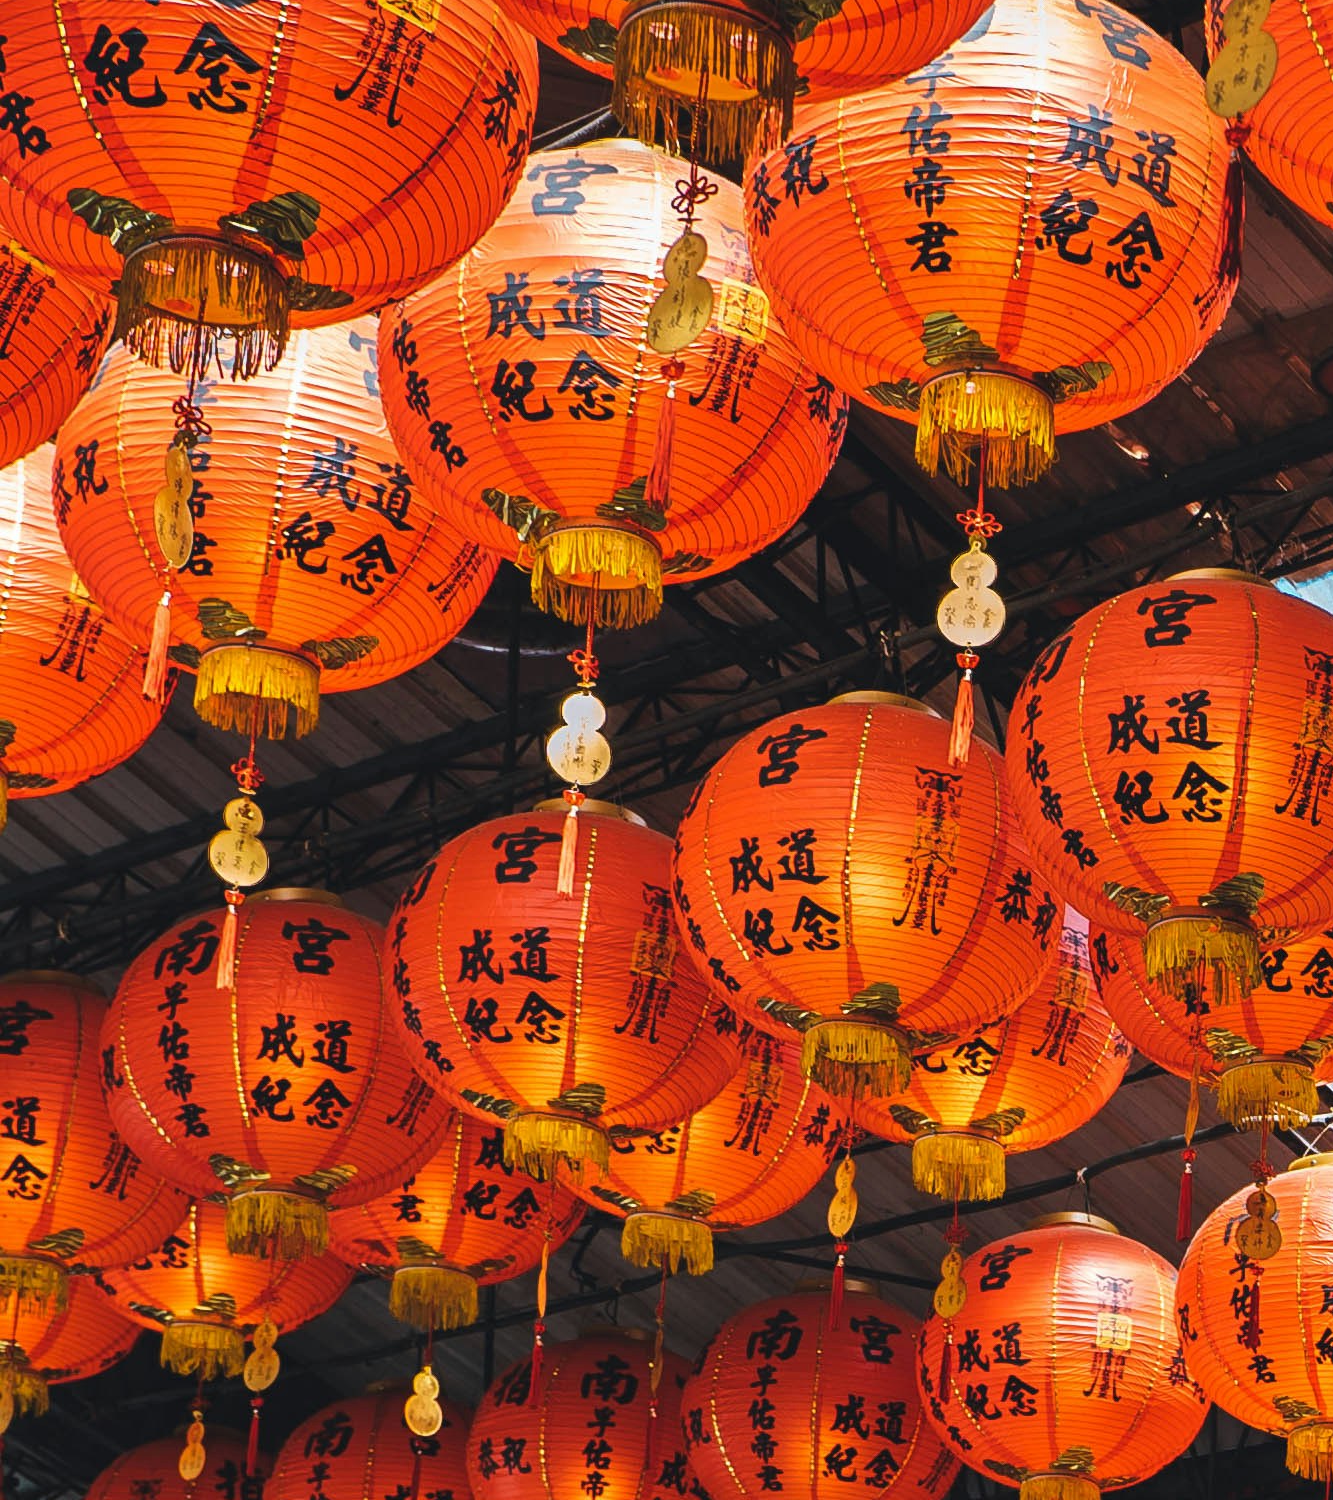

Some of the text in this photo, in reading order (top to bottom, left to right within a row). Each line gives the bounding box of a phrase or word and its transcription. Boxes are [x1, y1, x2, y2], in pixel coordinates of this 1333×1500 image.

[84, 23, 261, 114] 紀念
[1034, 193, 1165, 290] 紀念
[491, 351, 616, 423] 紀念
[276, 510, 399, 594] 紀念
[1108, 690, 1223, 754] 成道
[1114, 762, 1230, 824] 紀念
[731, 828, 830, 895] 成道
[457, 928, 560, 985] 成道
[744, 897, 840, 957] 紀念
[257, 1014, 356, 1074] 成道
[462, 991, 566, 1045] 紀念
[250, 1077, 351, 1128] 紀念
[830, 1393, 908, 1444] 成道
[821, 1445, 900, 1489] 紀念
